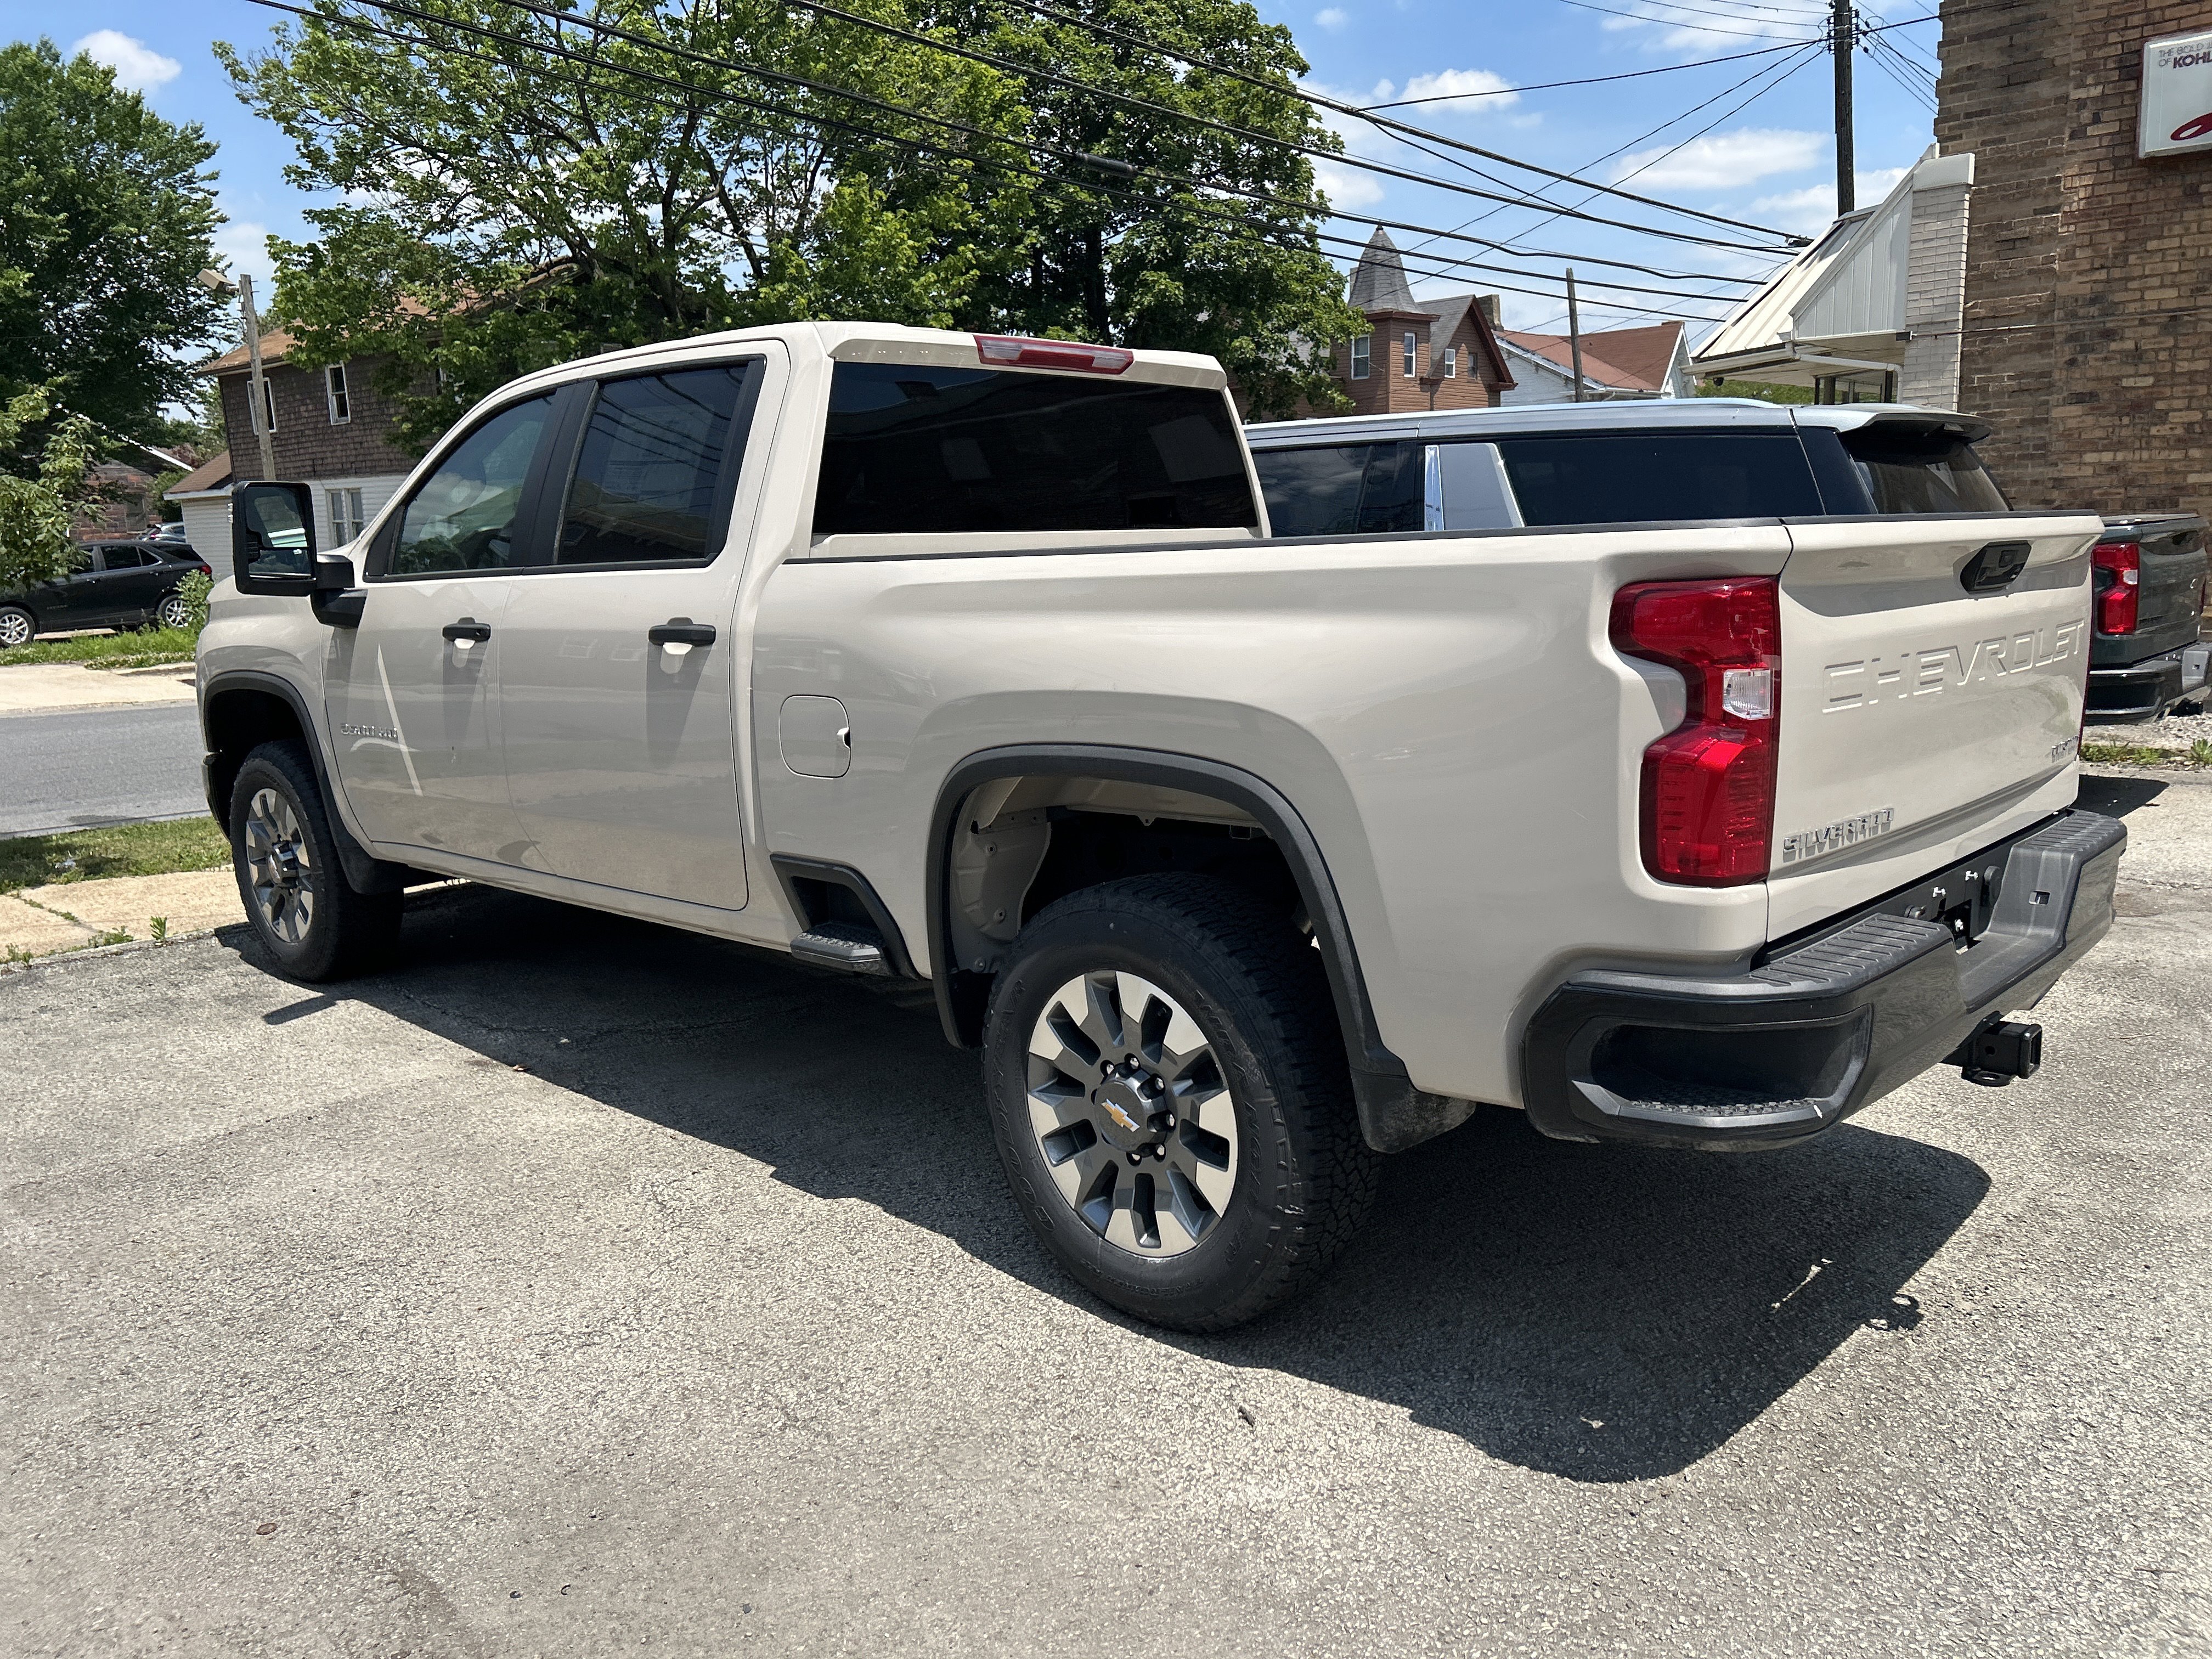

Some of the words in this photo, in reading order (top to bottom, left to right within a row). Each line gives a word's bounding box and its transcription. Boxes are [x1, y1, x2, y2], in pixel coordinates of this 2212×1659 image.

[2158, 58, 2172, 66] OF
[1821, 619, 2085, 714] CHEVROLET
[1782, 807, 1895, 851] SILVERADO
